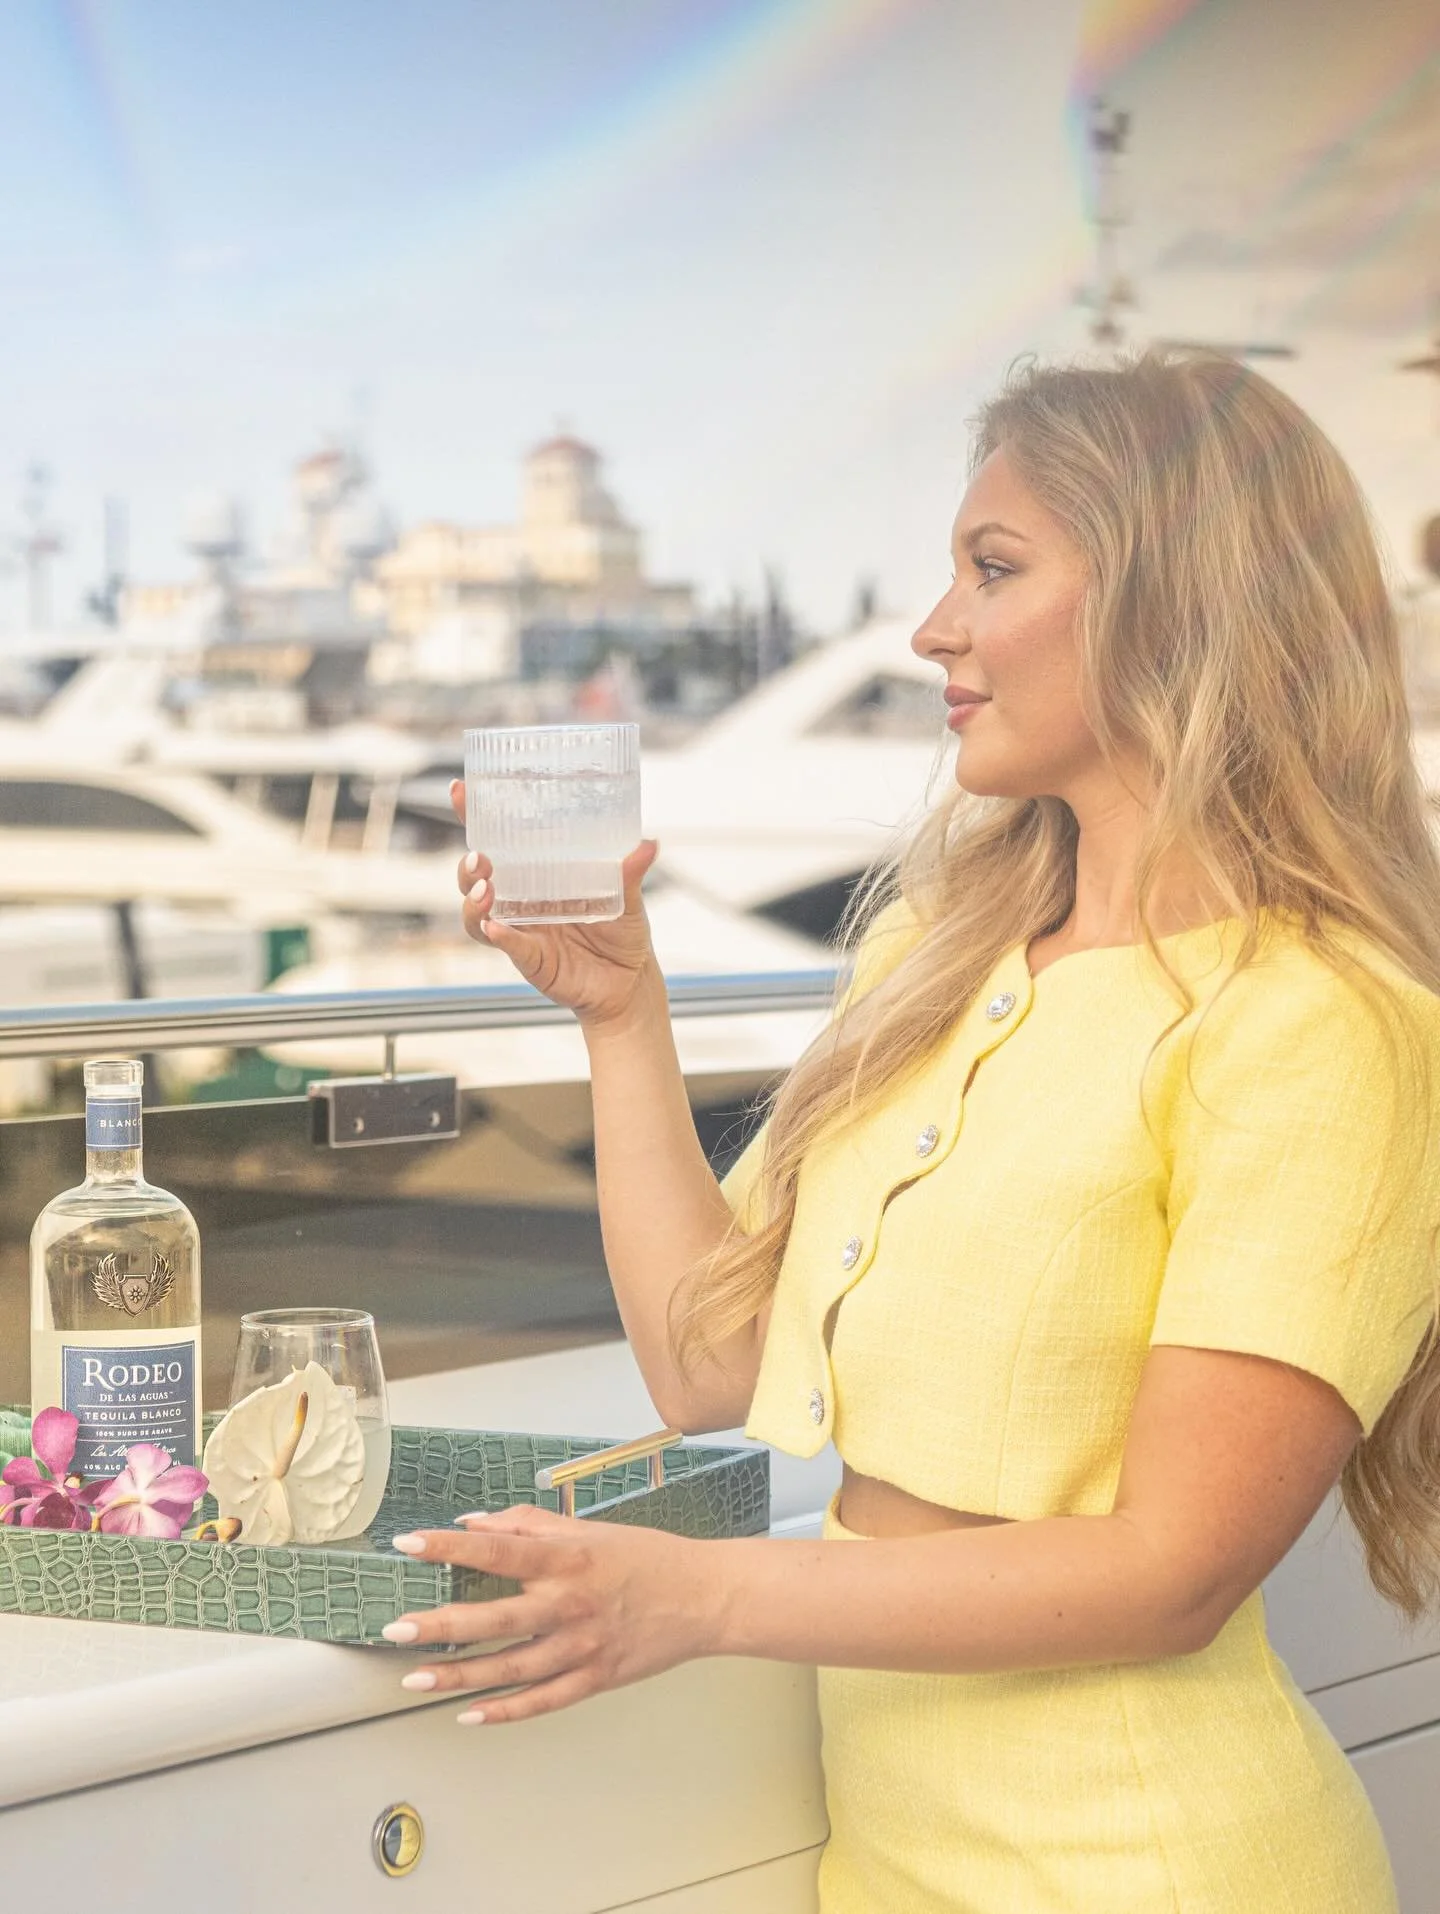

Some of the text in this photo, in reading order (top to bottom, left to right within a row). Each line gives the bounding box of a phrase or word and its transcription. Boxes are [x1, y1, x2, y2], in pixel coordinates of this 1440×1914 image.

[82, 1358, 182, 1392] RODEO
[100, 1393, 113, 1402] DE
[118, 1393, 137, 1402] LAS
[84, 1408, 182, 1421] TEQUILA BLANCO
